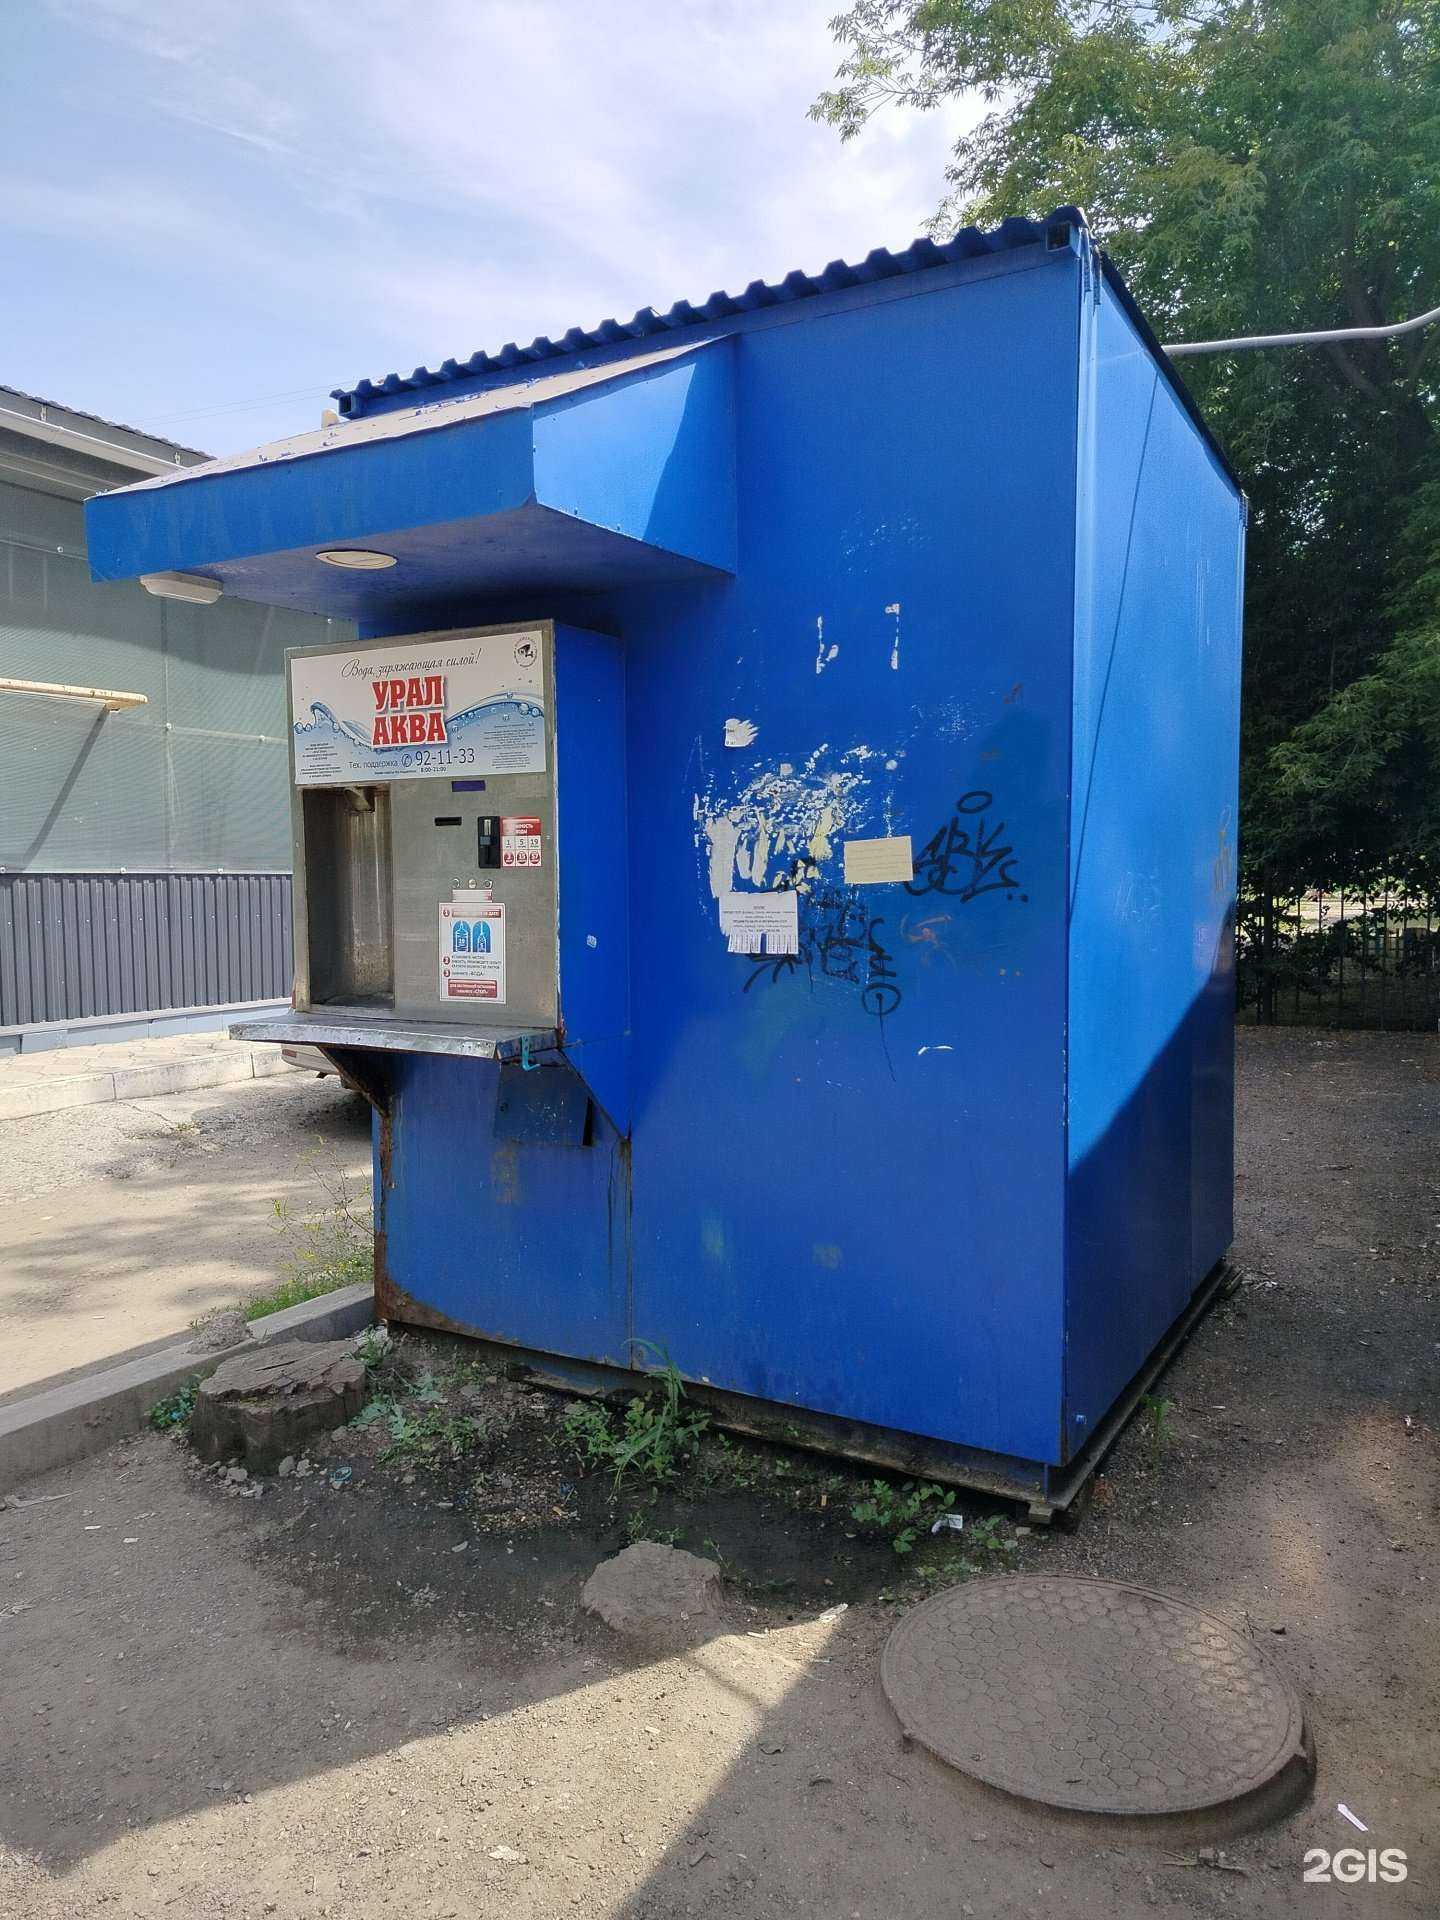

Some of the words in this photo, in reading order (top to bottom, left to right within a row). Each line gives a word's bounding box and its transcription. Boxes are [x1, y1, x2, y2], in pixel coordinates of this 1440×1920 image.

[341, 658, 375, 680] Вода,
[376, 659, 443, 679] заряжающая
[446, 648, 482, 668] силой!
[372, 675, 443, 710] УРАЛ
[372, 713, 446, 746] АКВА
[349, 761, 362, 769] Тех.
[415, 749, 475, 766] 92-11-33
